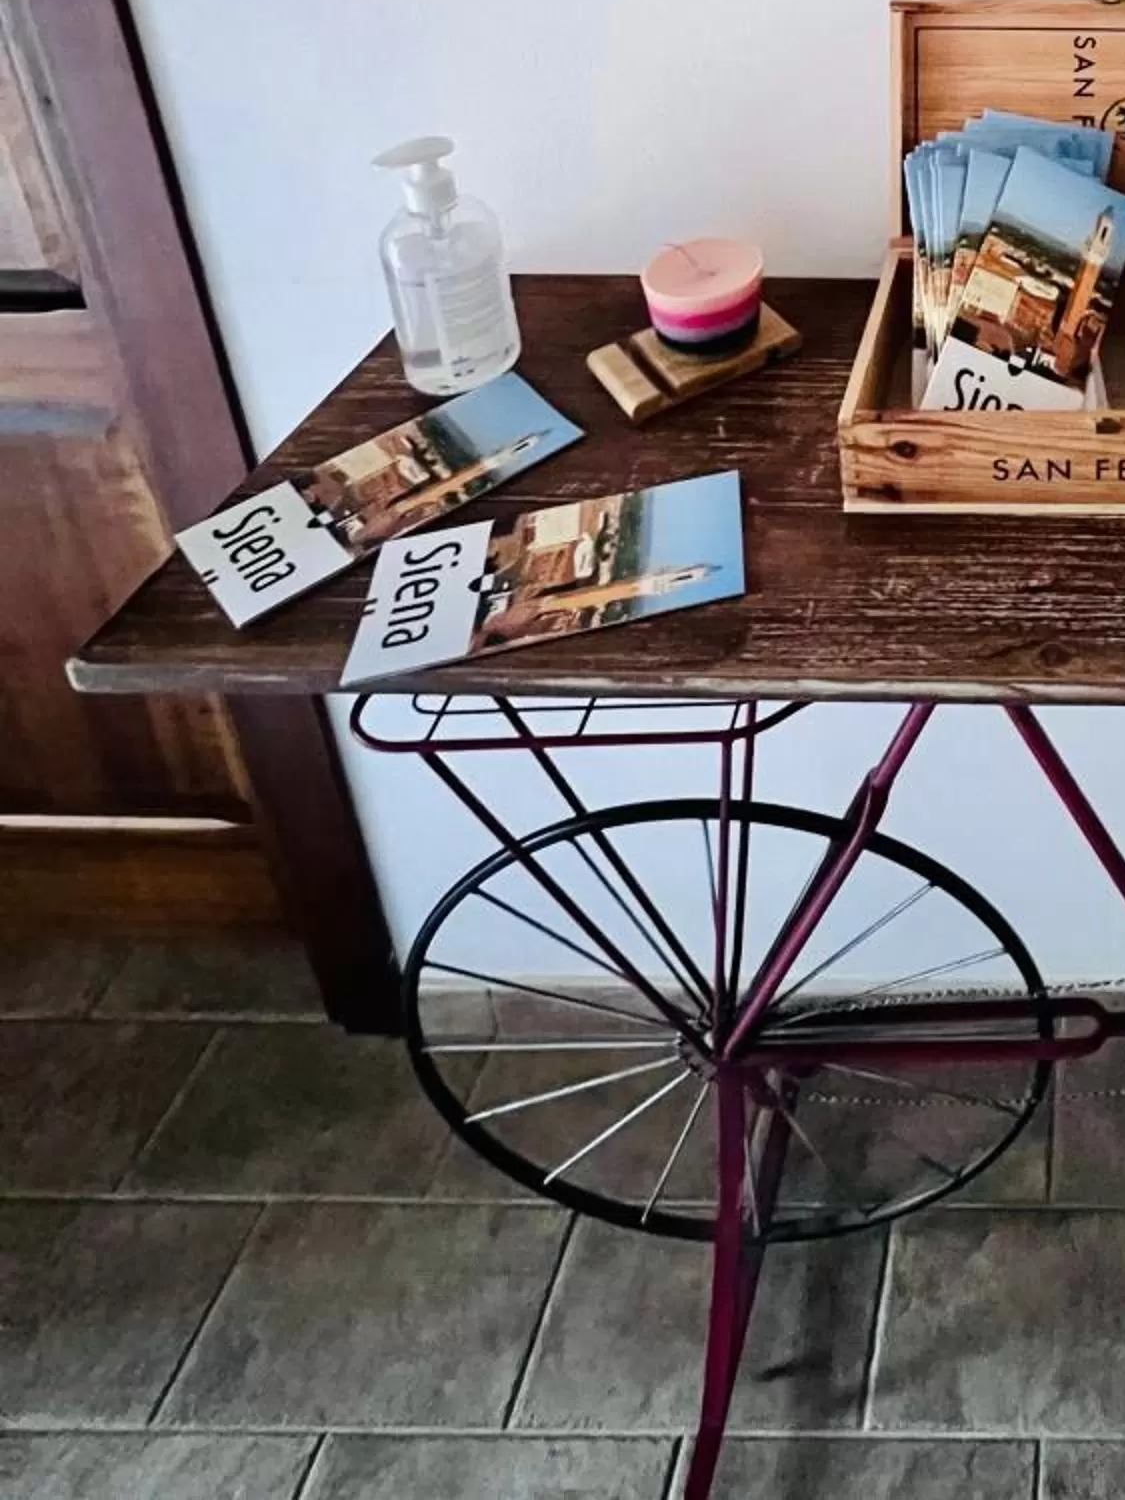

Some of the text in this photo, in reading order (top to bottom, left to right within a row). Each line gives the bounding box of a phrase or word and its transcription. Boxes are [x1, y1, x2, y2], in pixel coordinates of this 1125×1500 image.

[1073, 35, 1097, 97] SAN
[993, 458, 1072, 482] SAN
[212, 504, 297, 593] Siena
[381, 541, 462, 650] Siena
